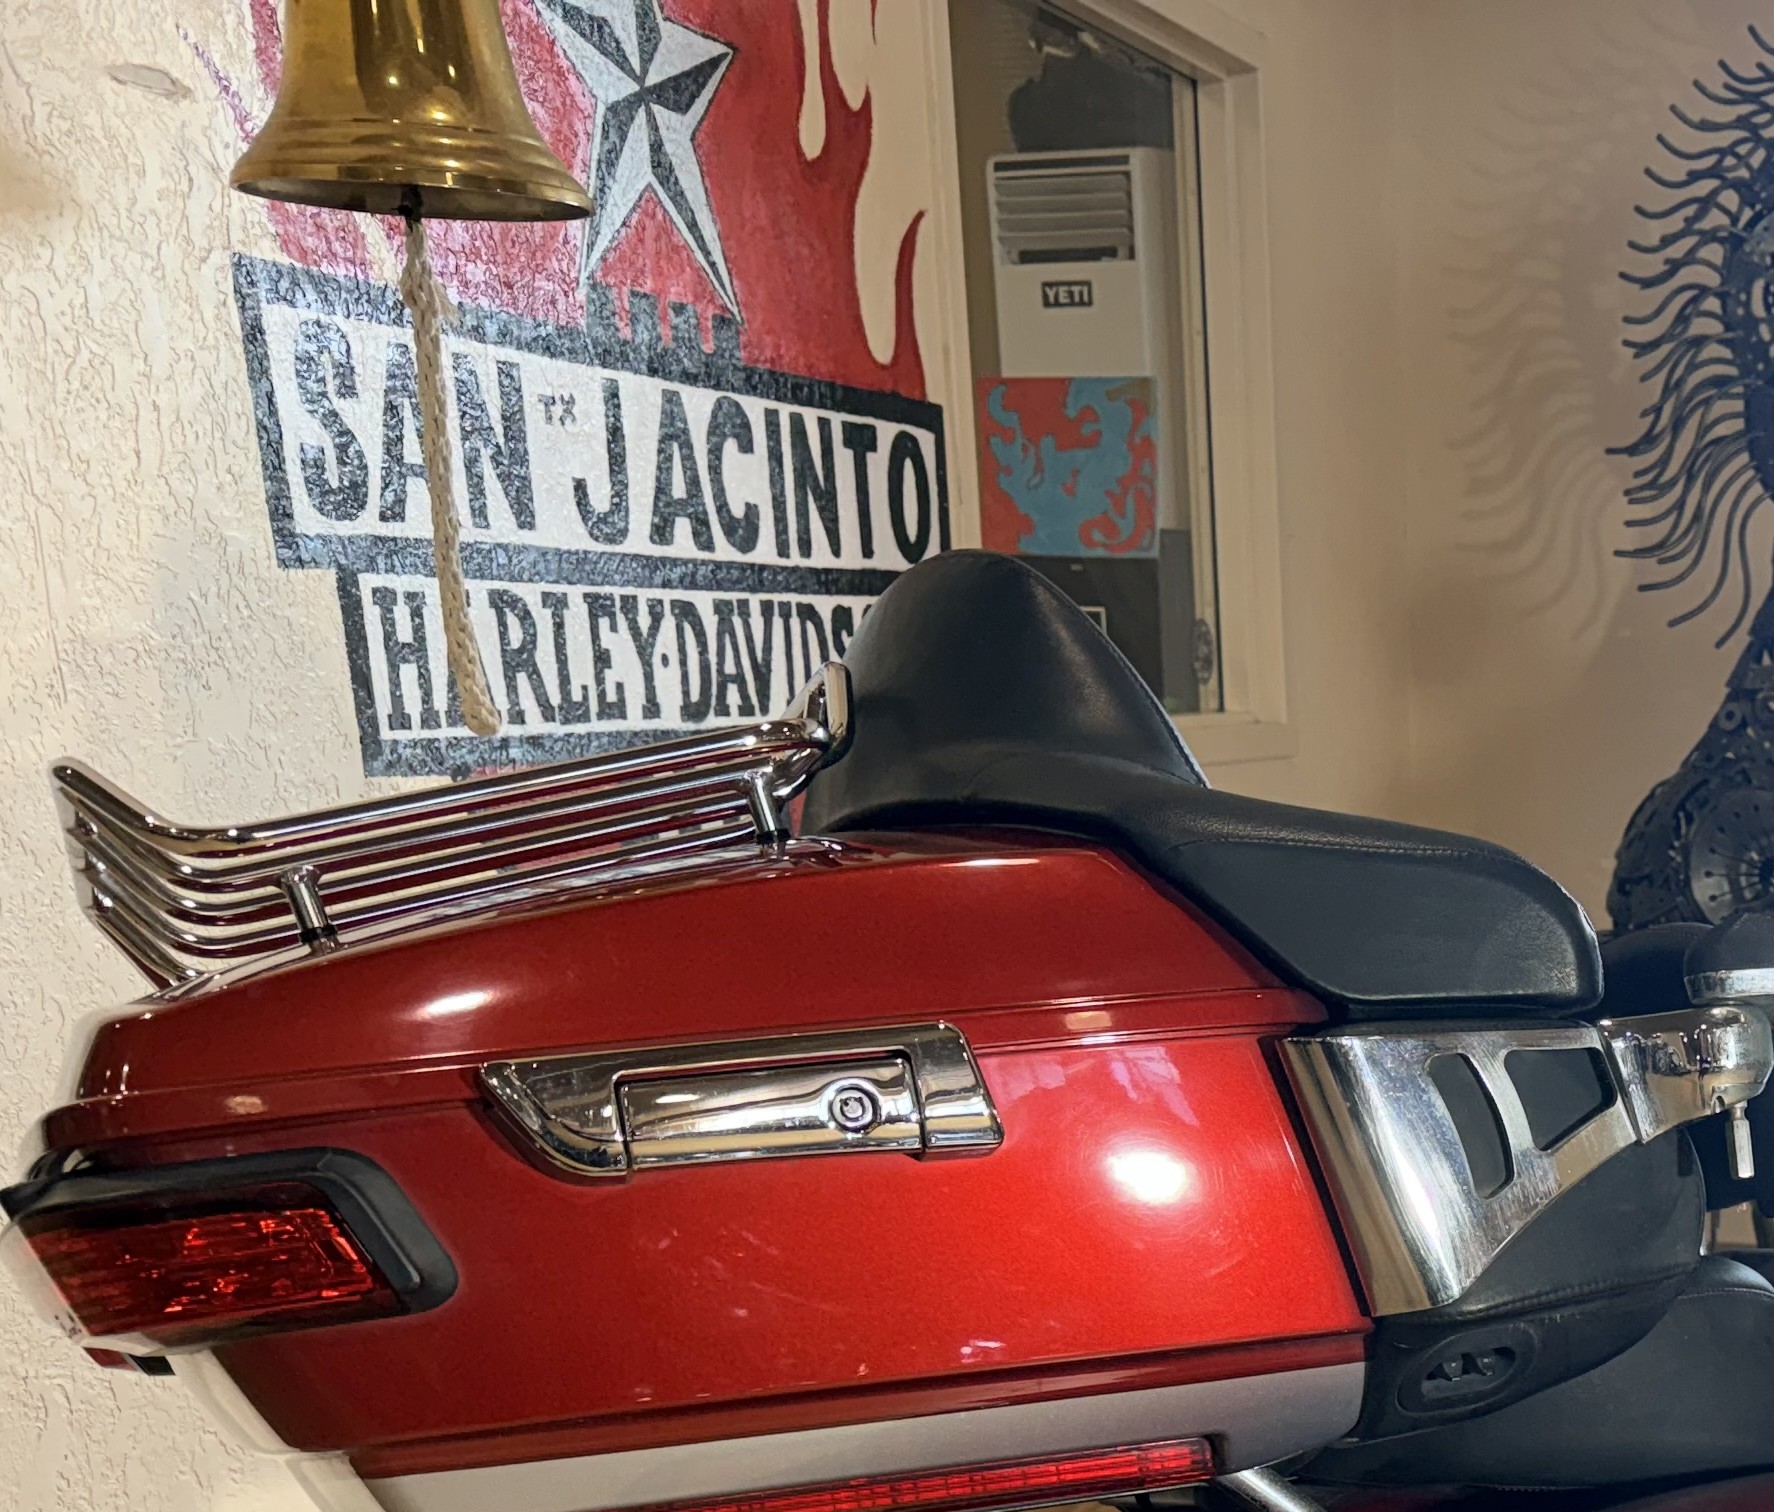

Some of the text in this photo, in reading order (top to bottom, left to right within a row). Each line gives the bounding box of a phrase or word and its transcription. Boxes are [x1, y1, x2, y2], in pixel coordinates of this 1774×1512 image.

[1045, 285, 1089, 304] YETI
[294, 317, 932, 565] SAN TX JACINTO
